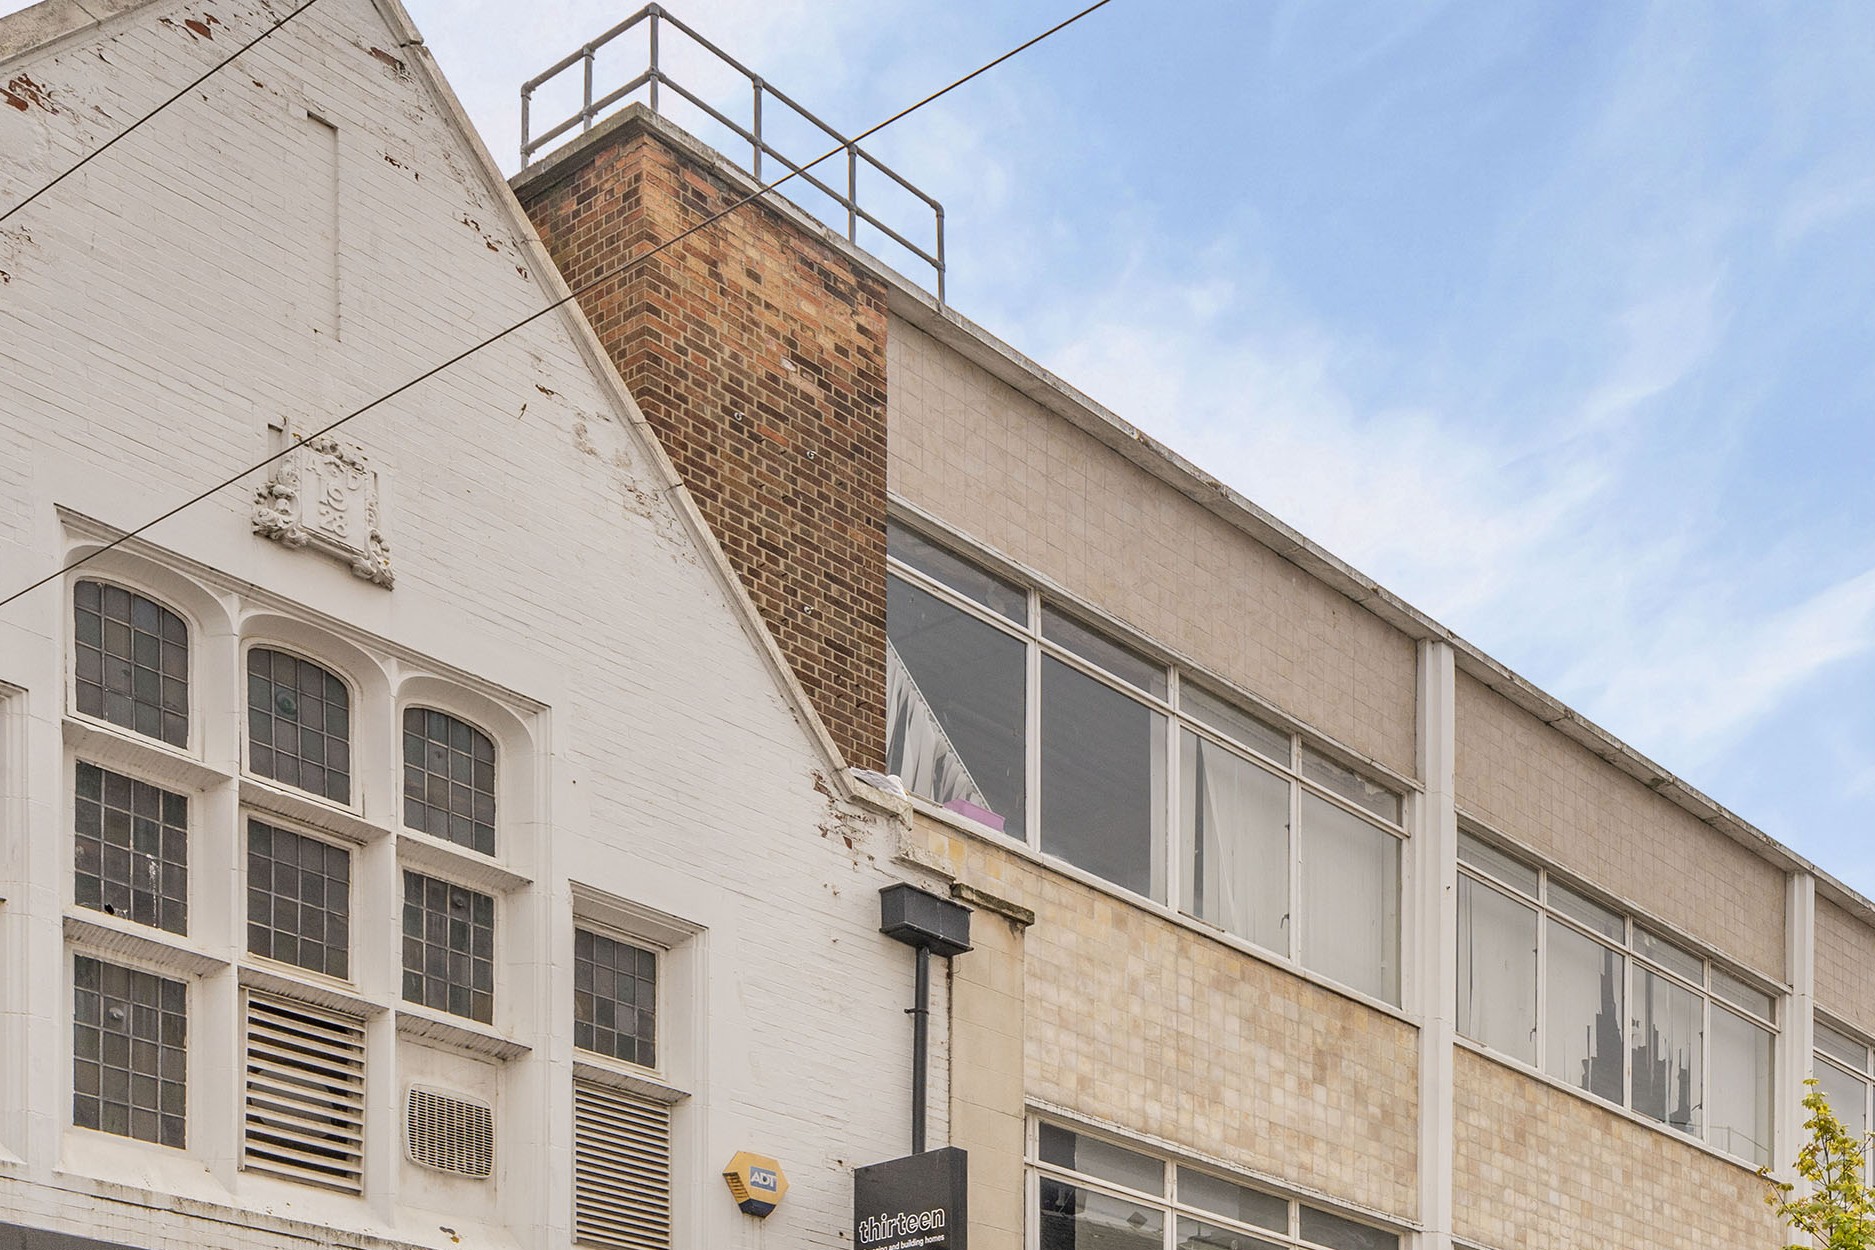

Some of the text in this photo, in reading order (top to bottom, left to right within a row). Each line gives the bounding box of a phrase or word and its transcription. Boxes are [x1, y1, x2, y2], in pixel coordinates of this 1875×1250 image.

[318, 507, 349, 539] 28
[751, 1171, 776, 1188] ADT
[859, 1208, 945, 1243] thirteen
[889, 1243, 900, 1250] and
[901, 1238, 923, 1250] building
[925, 1234, 945, 1245] homes
